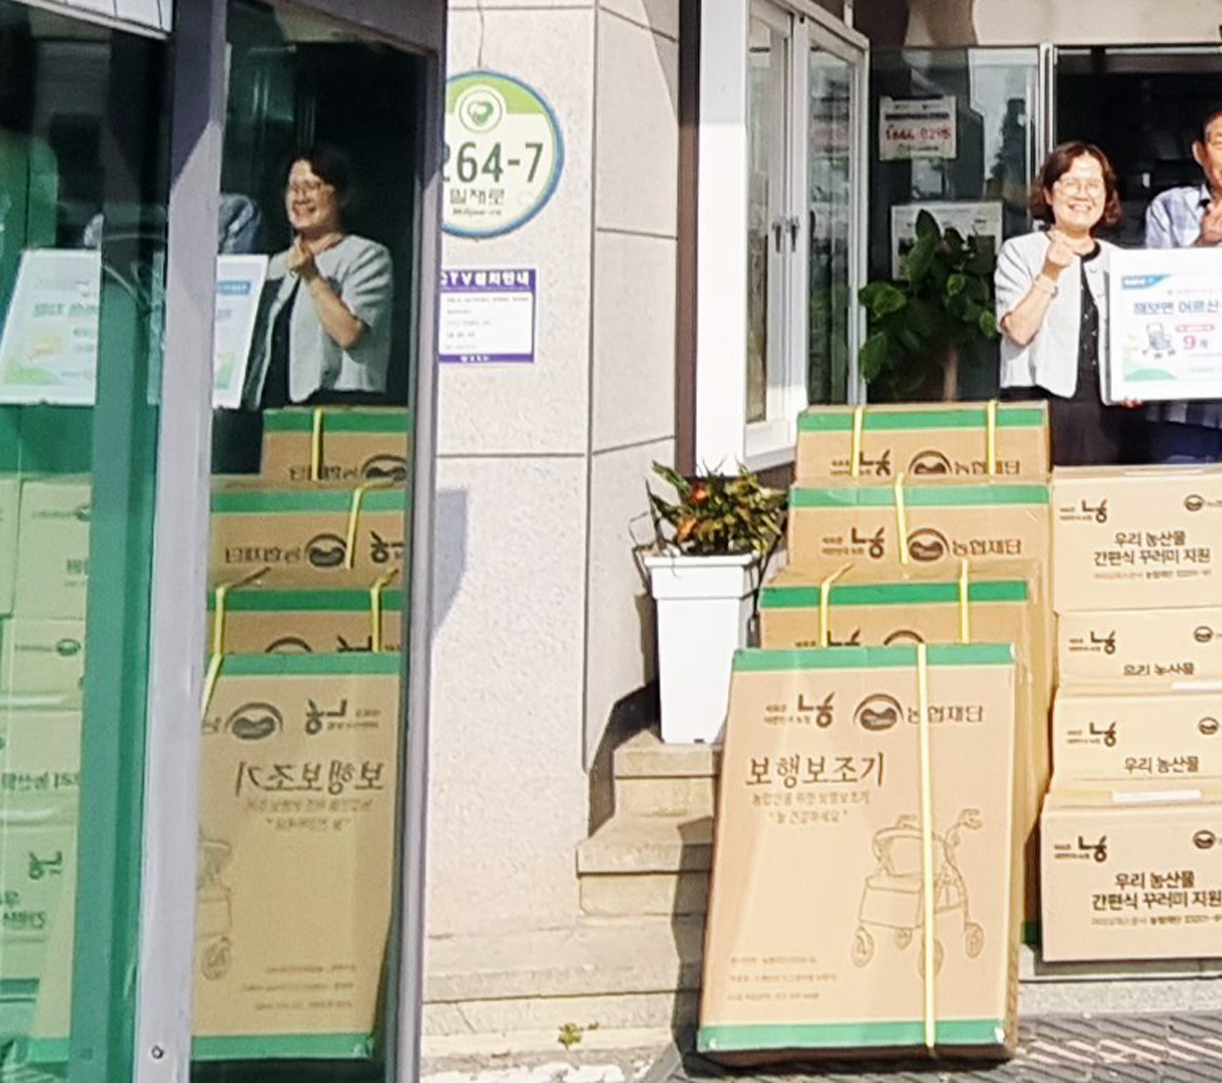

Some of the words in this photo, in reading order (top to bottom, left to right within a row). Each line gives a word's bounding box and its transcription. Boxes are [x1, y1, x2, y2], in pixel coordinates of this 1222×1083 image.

[1133, 300, 1175, 315] 해보면
[1178, 298, 1220, 313] 어르신
[1114, 532, 1142, 548] 우리
[1145, 530, 1186, 547] 농산물
[1093, 550, 1135, 567] 간편식
[1139, 549, 1180, 565] 꾸러미
[1183, 547, 1211, 563] 지원
[797, 691, 836, 729] 농
[745, 751, 885, 789] 보행보조기
[1124, 756, 1152, 774] 우리
[1157, 755, 1199, 773] 농산물
[1077, 834, 1108, 863] 농
[1114, 872, 1146, 890] 우리
[1149, 870, 1195, 889] 농산물
[1091, 892, 1138, 911] 간편식
[1142, 891, 1188, 909] 꾸러미
[1191, 889, 1222, 908] 지원
